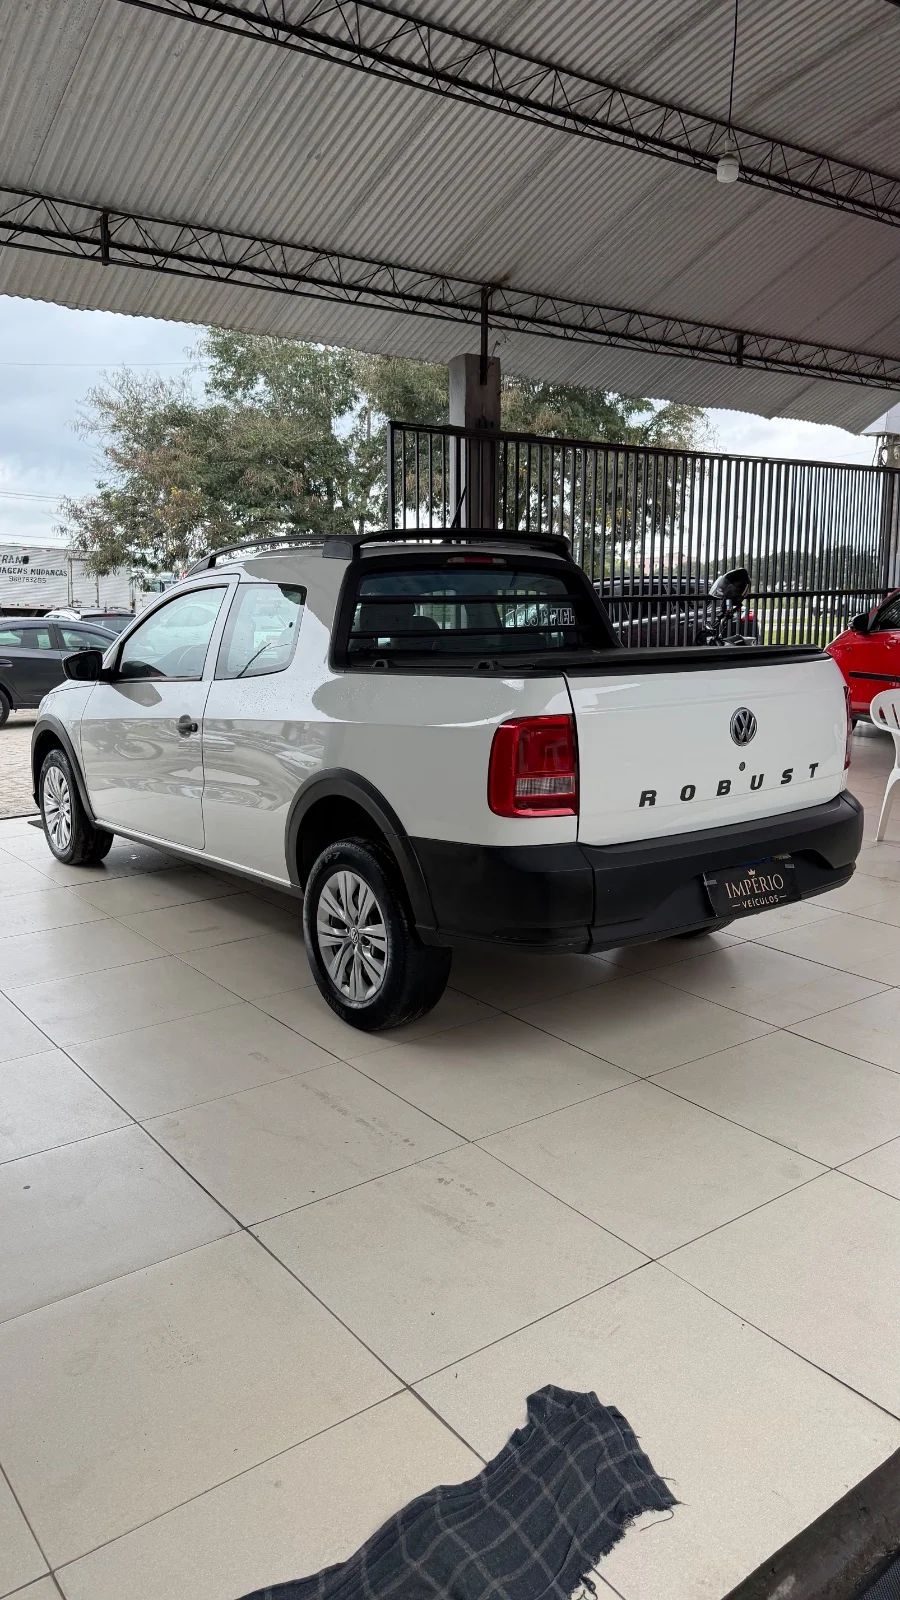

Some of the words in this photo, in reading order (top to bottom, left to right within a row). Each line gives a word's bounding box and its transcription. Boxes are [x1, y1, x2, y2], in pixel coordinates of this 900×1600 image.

[638, 762, 819, 808] ROBUST
[724, 873, 784, 899] IMPÉRIO
[741, 894, 779, 909] VEÍCULOS
